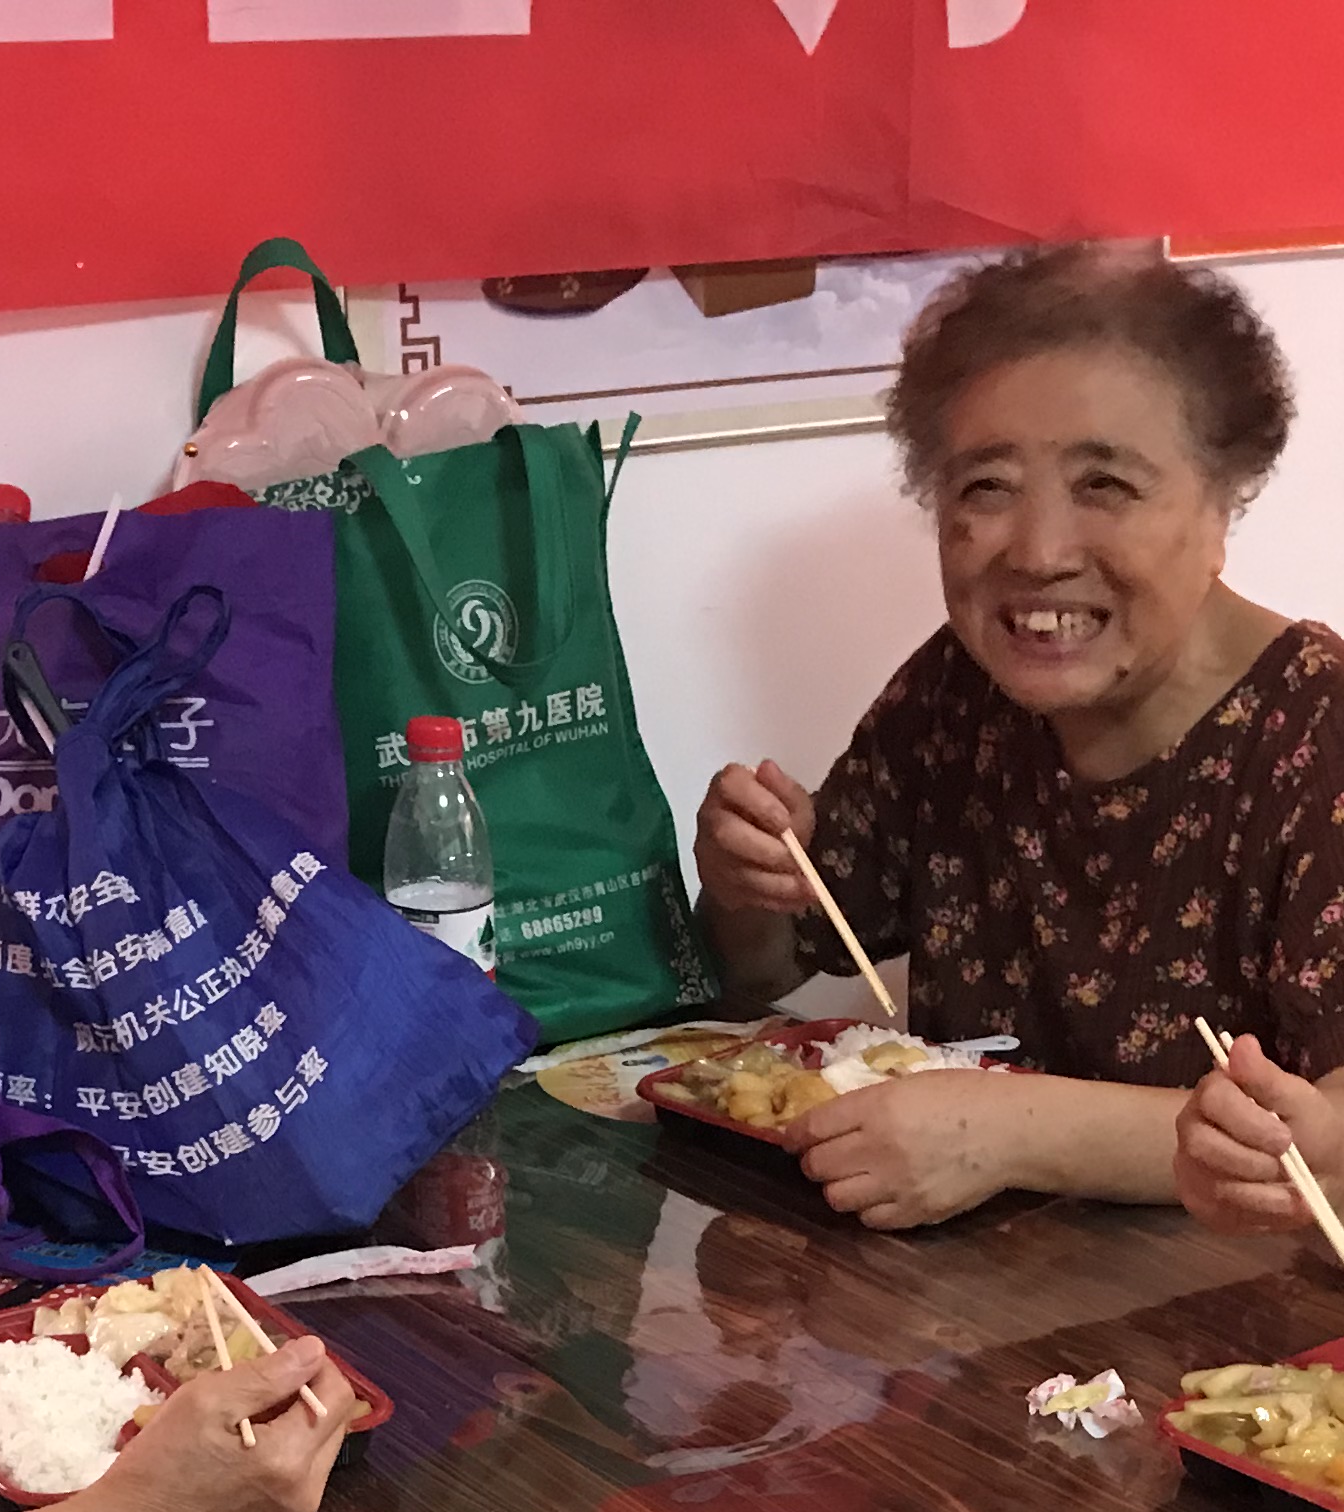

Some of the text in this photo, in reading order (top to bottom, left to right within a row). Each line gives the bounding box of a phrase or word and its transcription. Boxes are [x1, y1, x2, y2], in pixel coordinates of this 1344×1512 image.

[374, 682, 606, 769] 武市第九医院
[465, 740, 531, 770] HOSPITAL
[533, 732, 552, 747] OF
[555, 721, 609, 744] WUHAN
[76, 1001, 288, 1121] 平安创建知晓率
